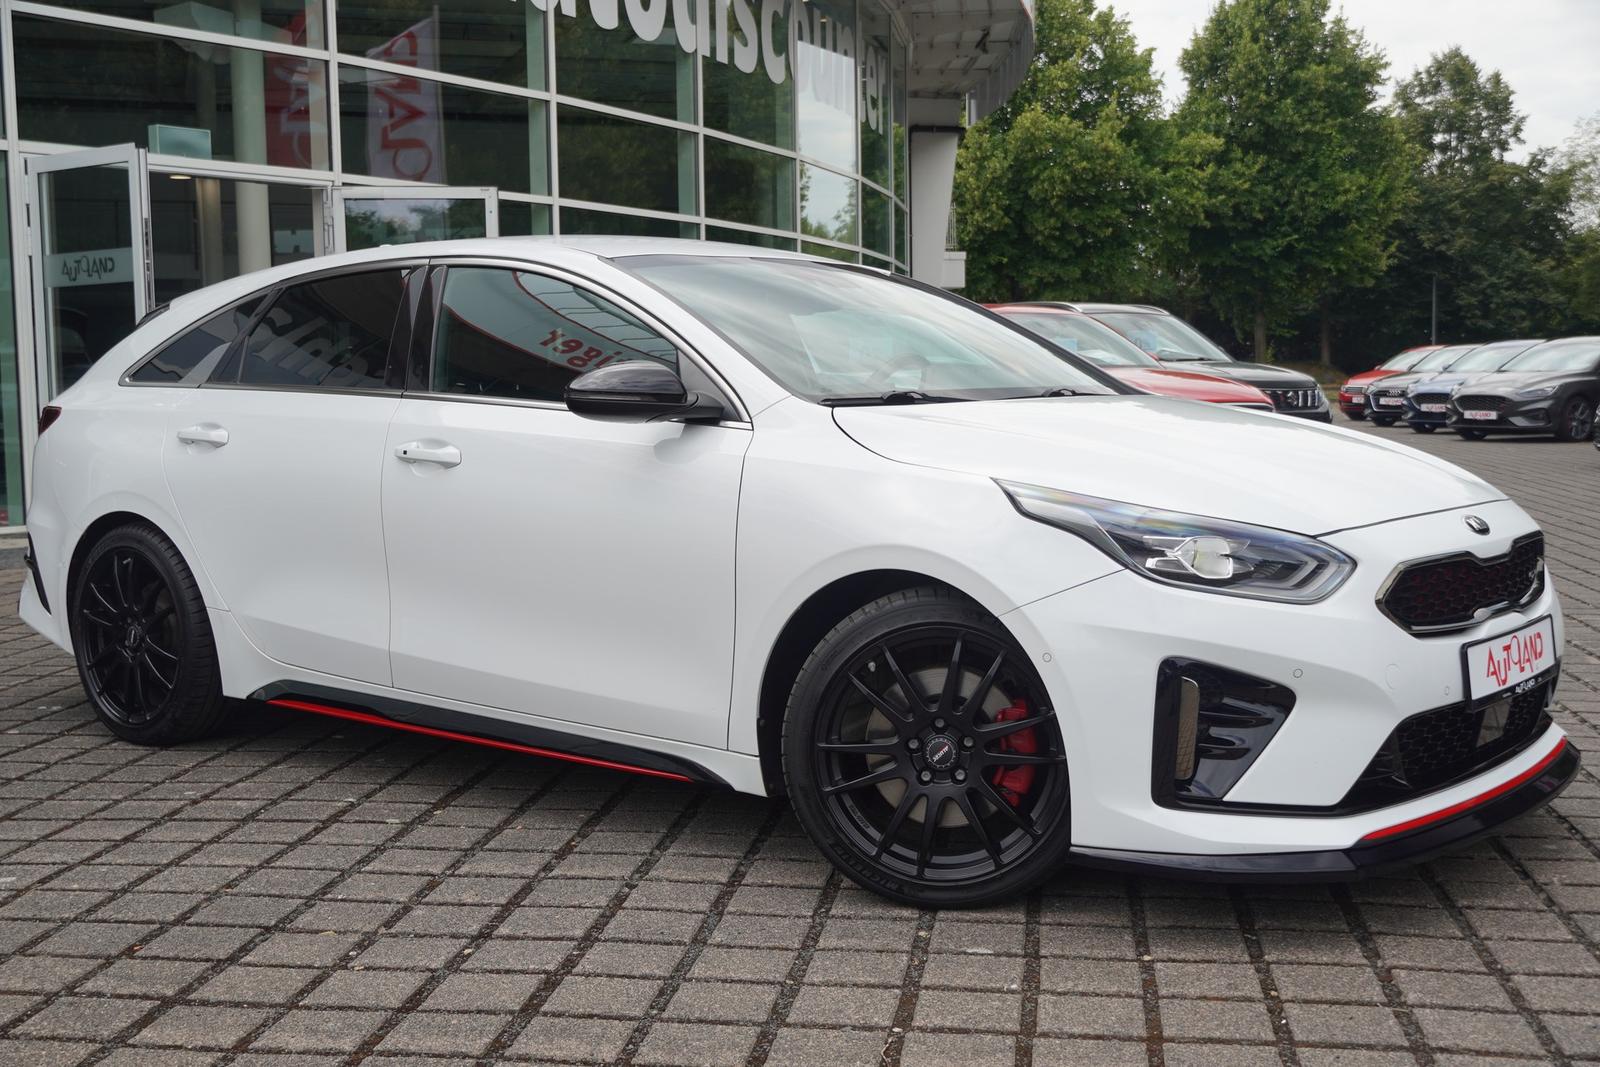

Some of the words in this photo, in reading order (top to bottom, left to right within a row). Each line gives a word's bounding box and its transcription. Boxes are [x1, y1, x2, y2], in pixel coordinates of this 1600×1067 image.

[511, 0, 886, 136] iscounter
[61, 255, 115, 282] AUTOLAND
[1486, 632, 1543, 687] AUTOLAND
